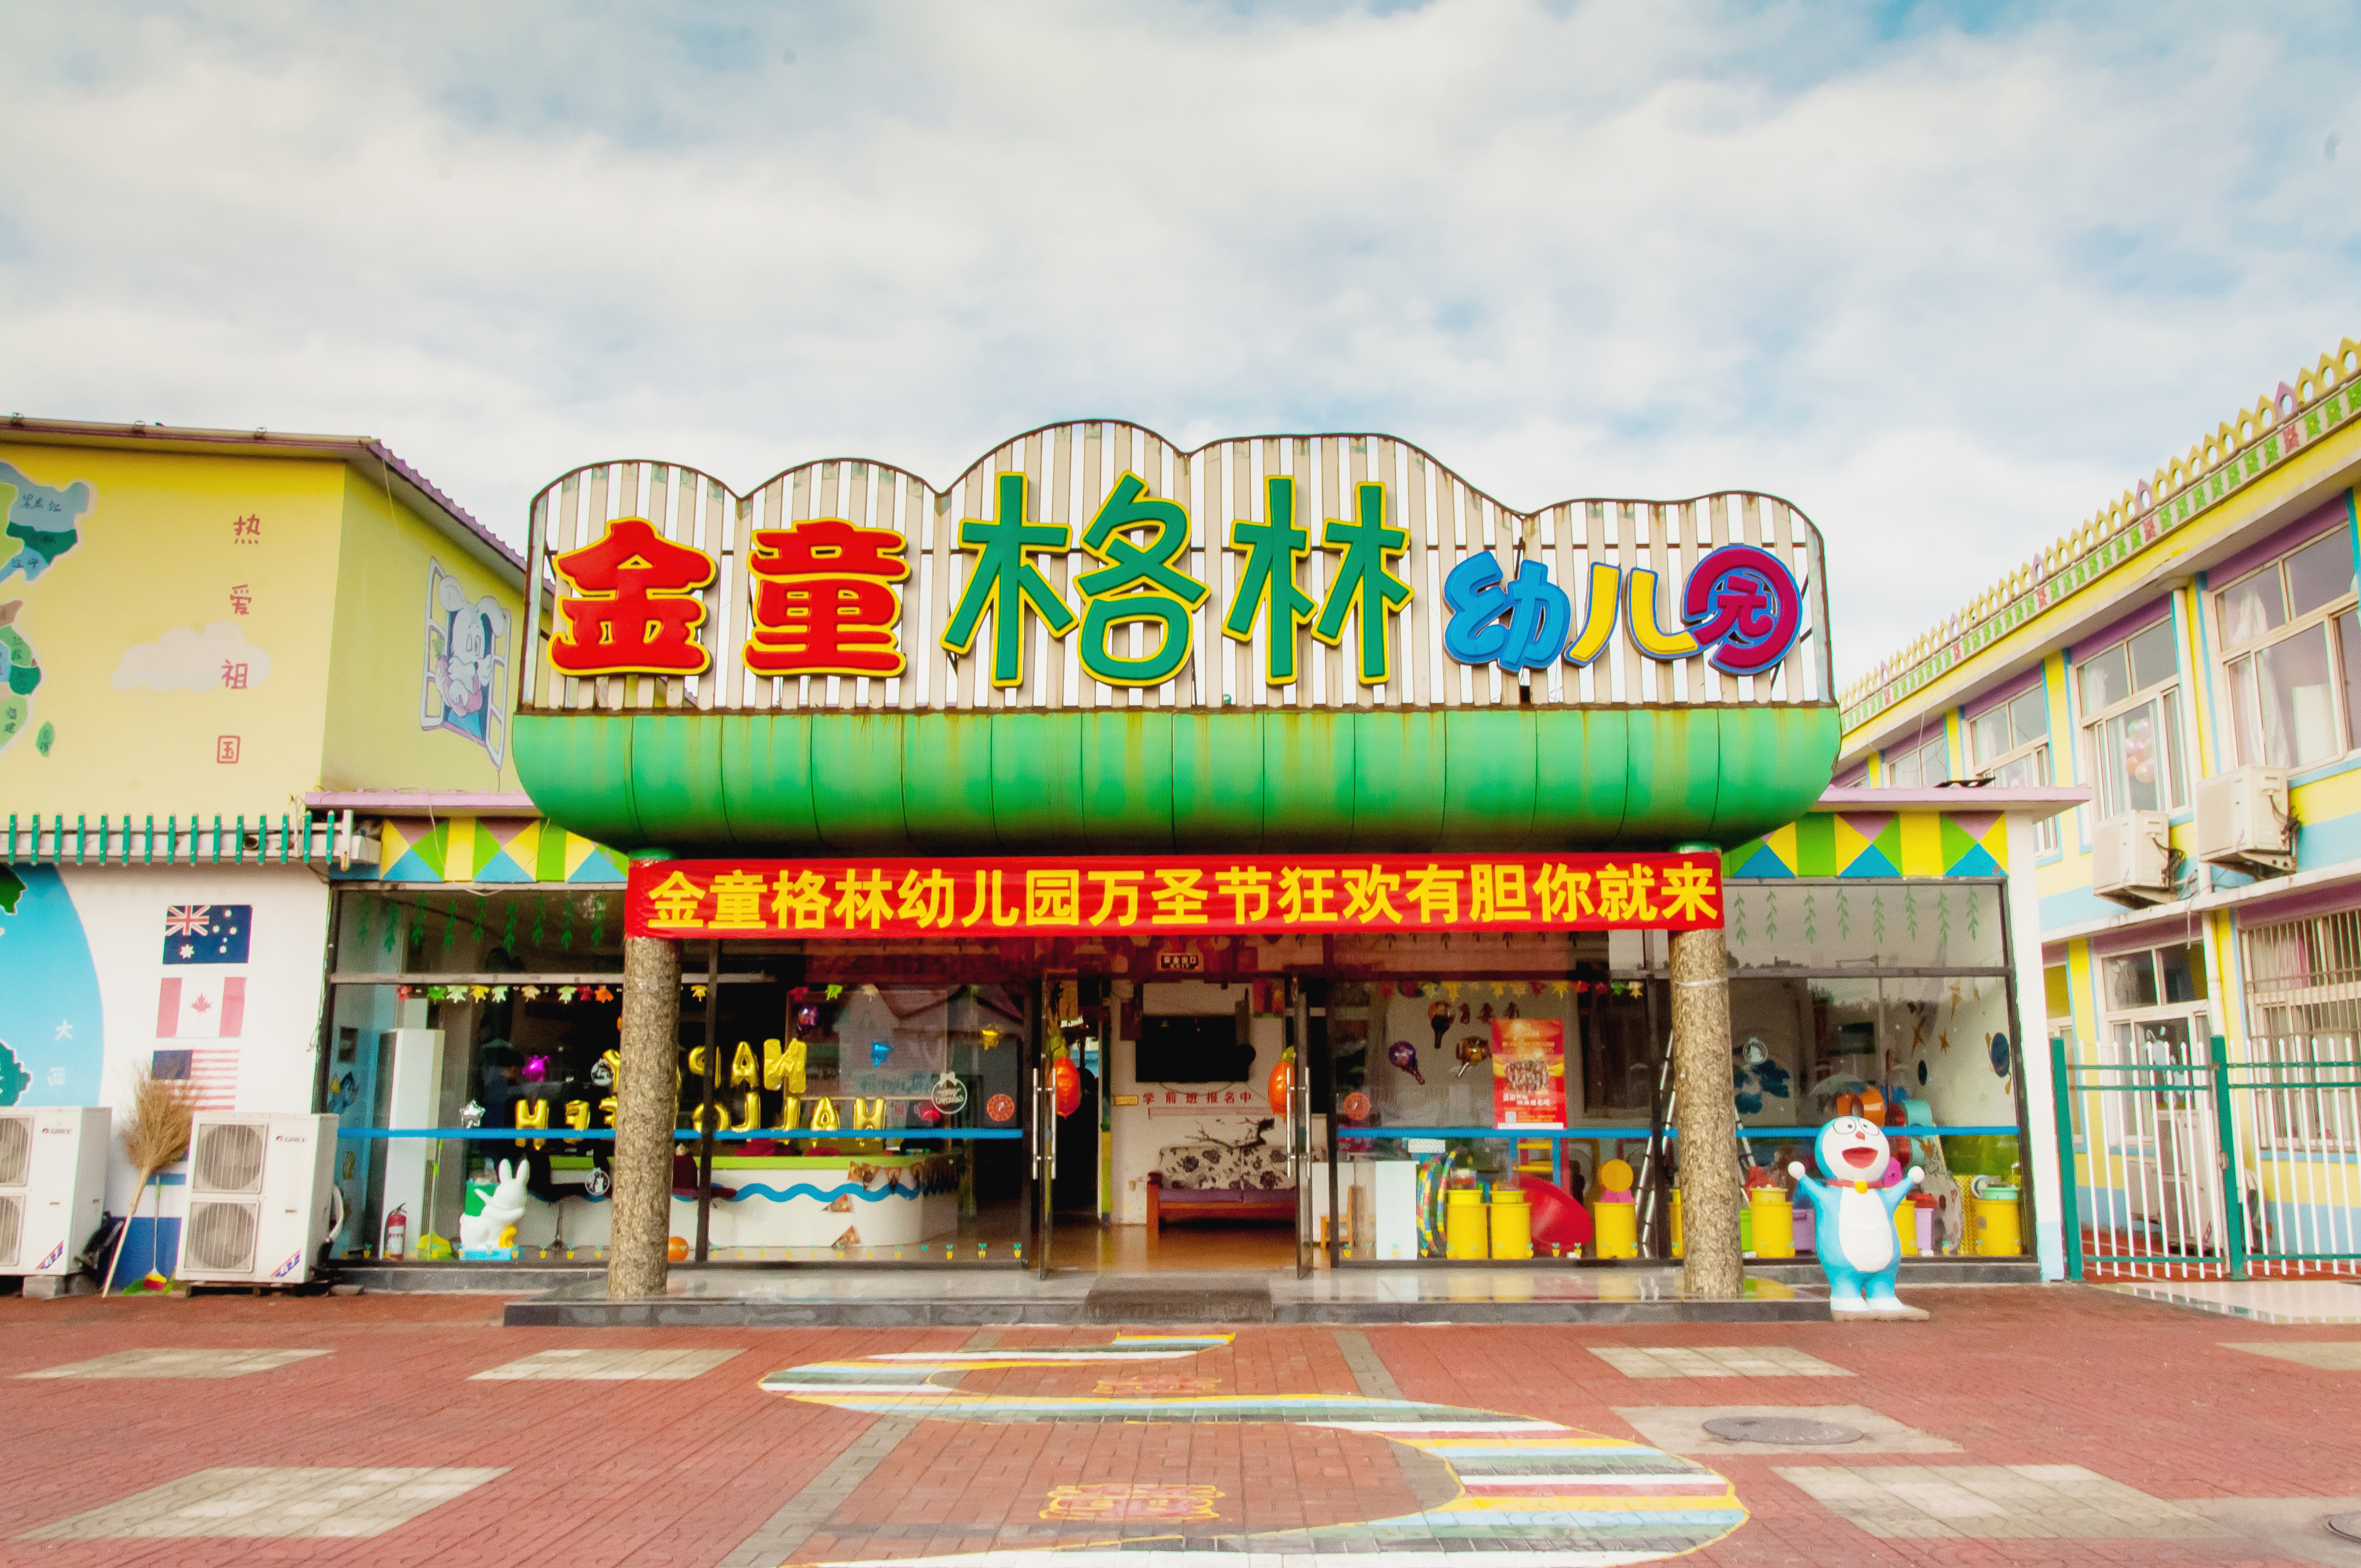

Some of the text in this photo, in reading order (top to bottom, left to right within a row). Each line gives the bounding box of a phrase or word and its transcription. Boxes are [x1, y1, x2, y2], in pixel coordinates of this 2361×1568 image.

[217, 514, 261, 764] 热爱祖国
[547, 471, 1803, 688] 金童格林幼儿园
[647, 863, 1718, 929] 金童格林幼儿园万圣节狂欢有胆你就来
